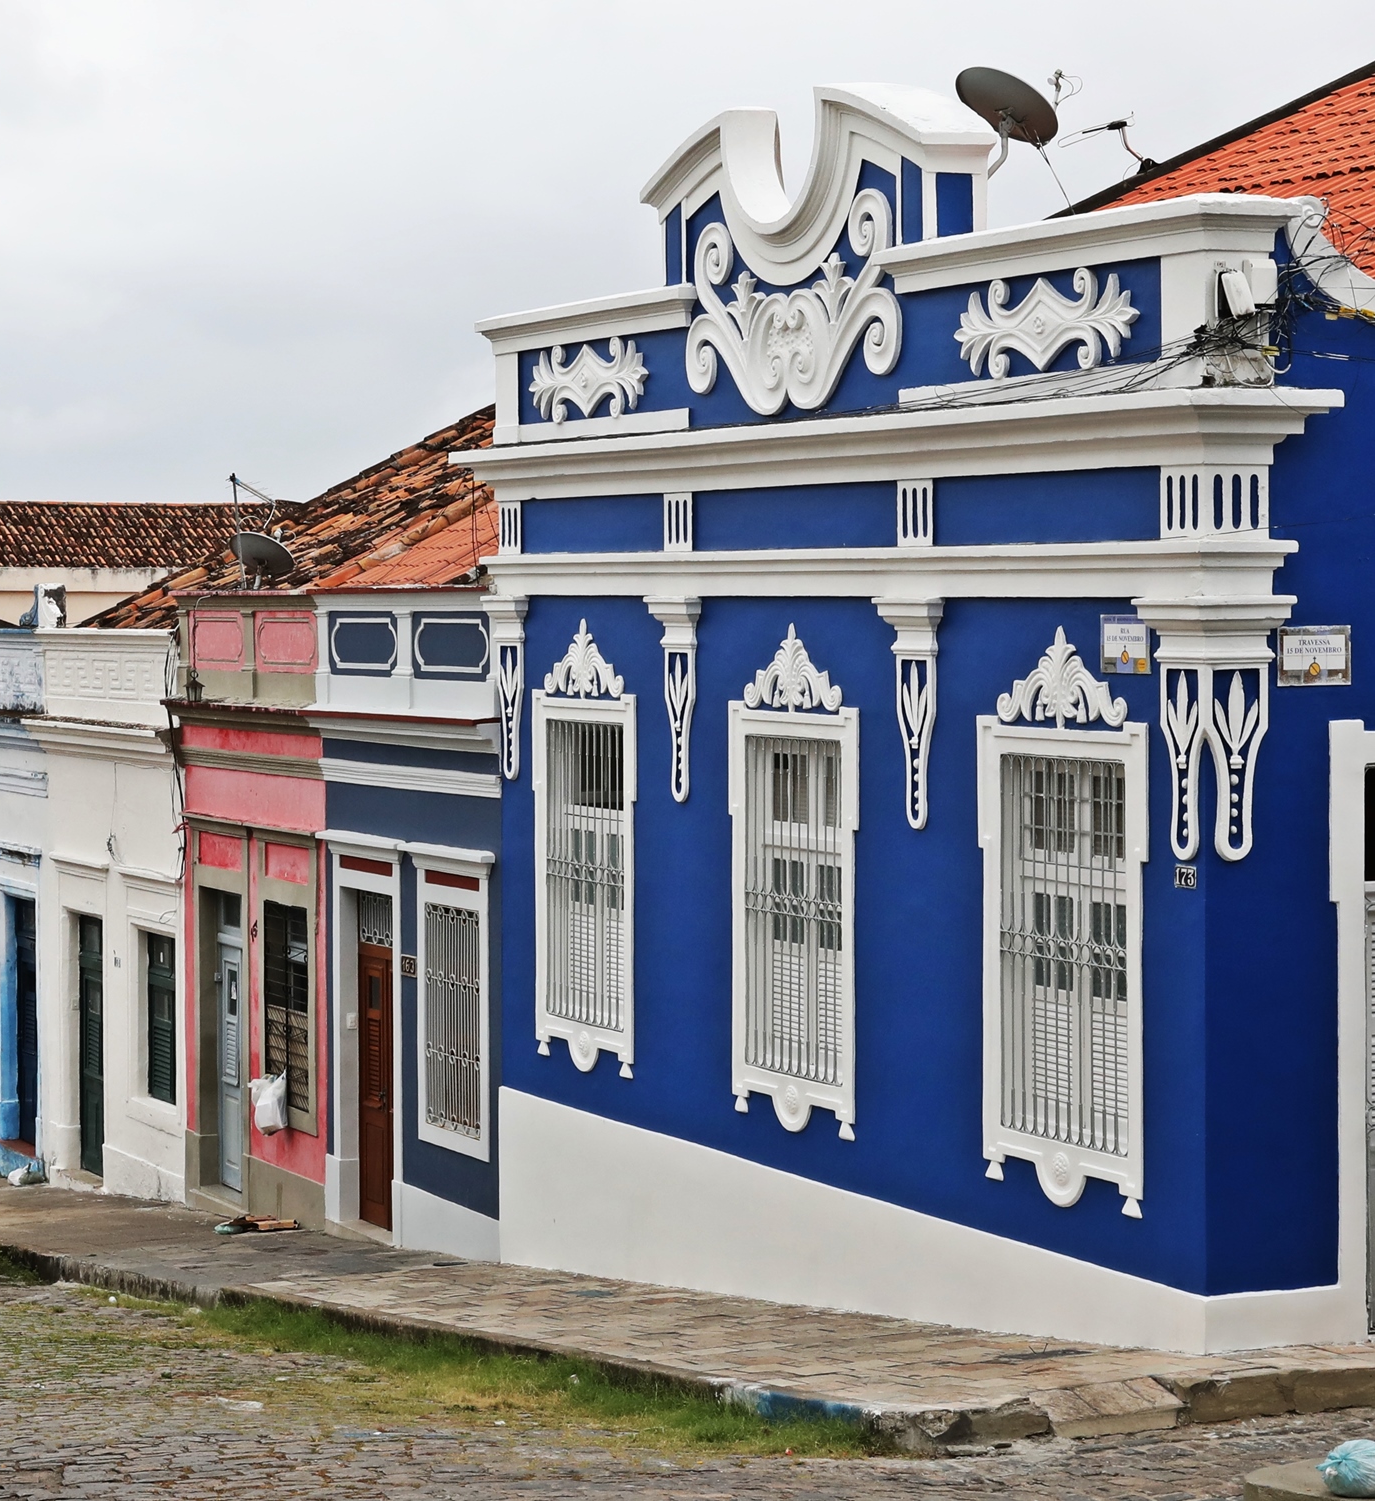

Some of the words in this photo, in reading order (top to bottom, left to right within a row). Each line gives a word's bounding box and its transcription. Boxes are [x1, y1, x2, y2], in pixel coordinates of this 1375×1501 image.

[1118, 635, 1144, 643] NOVEMBRO
[1286, 647, 1294, 655] 15
[1304, 646, 1342, 654] NOVEMBRO
[1175, 867, 1195, 886] 173
[402, 958, 415, 973] 163
